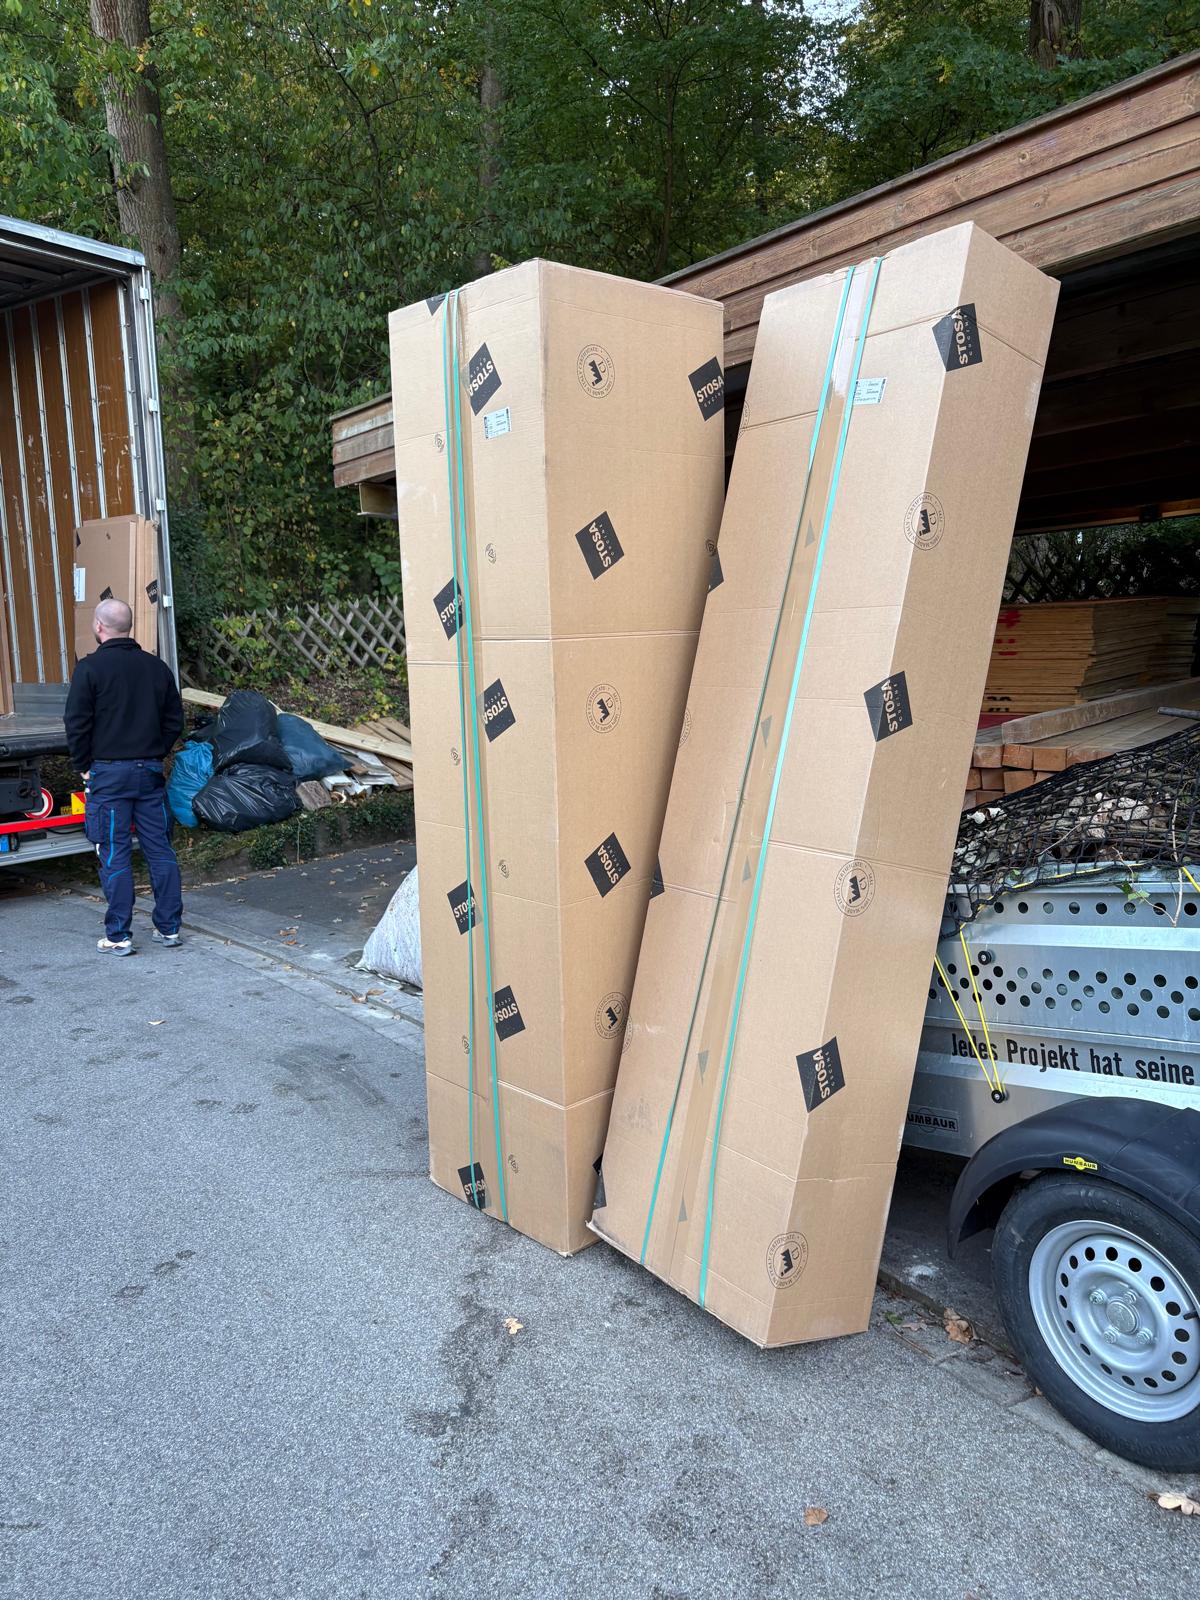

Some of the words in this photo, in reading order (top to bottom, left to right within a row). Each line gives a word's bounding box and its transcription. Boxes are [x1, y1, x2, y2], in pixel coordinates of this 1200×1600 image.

[950, 308, 968, 364] STOSA
[467, 360, 494, 397] STOSA
[468, 356, 487, 379] CUCIN
[696, 376, 724, 403] STOSA
[588, 522, 612, 568] STOSA
[482, 696, 508, 724] STOSA
[485, 692, 501, 708] CUCIN
[881, 680, 898, 732] STOSA
[597, 845, 619, 884] STOSA
[494, 1002, 518, 1024] STOSA
[812, 1050, 830, 1099] STOSA
[952, 1033, 998, 1061] Jedes
[1006, 1039, 1080, 1073] Projekt
[1090, 1048, 1124, 1077] hat
[1135, 1056, 1195, 1086] seine
[906, 1112, 956, 1130] UMBAUR
